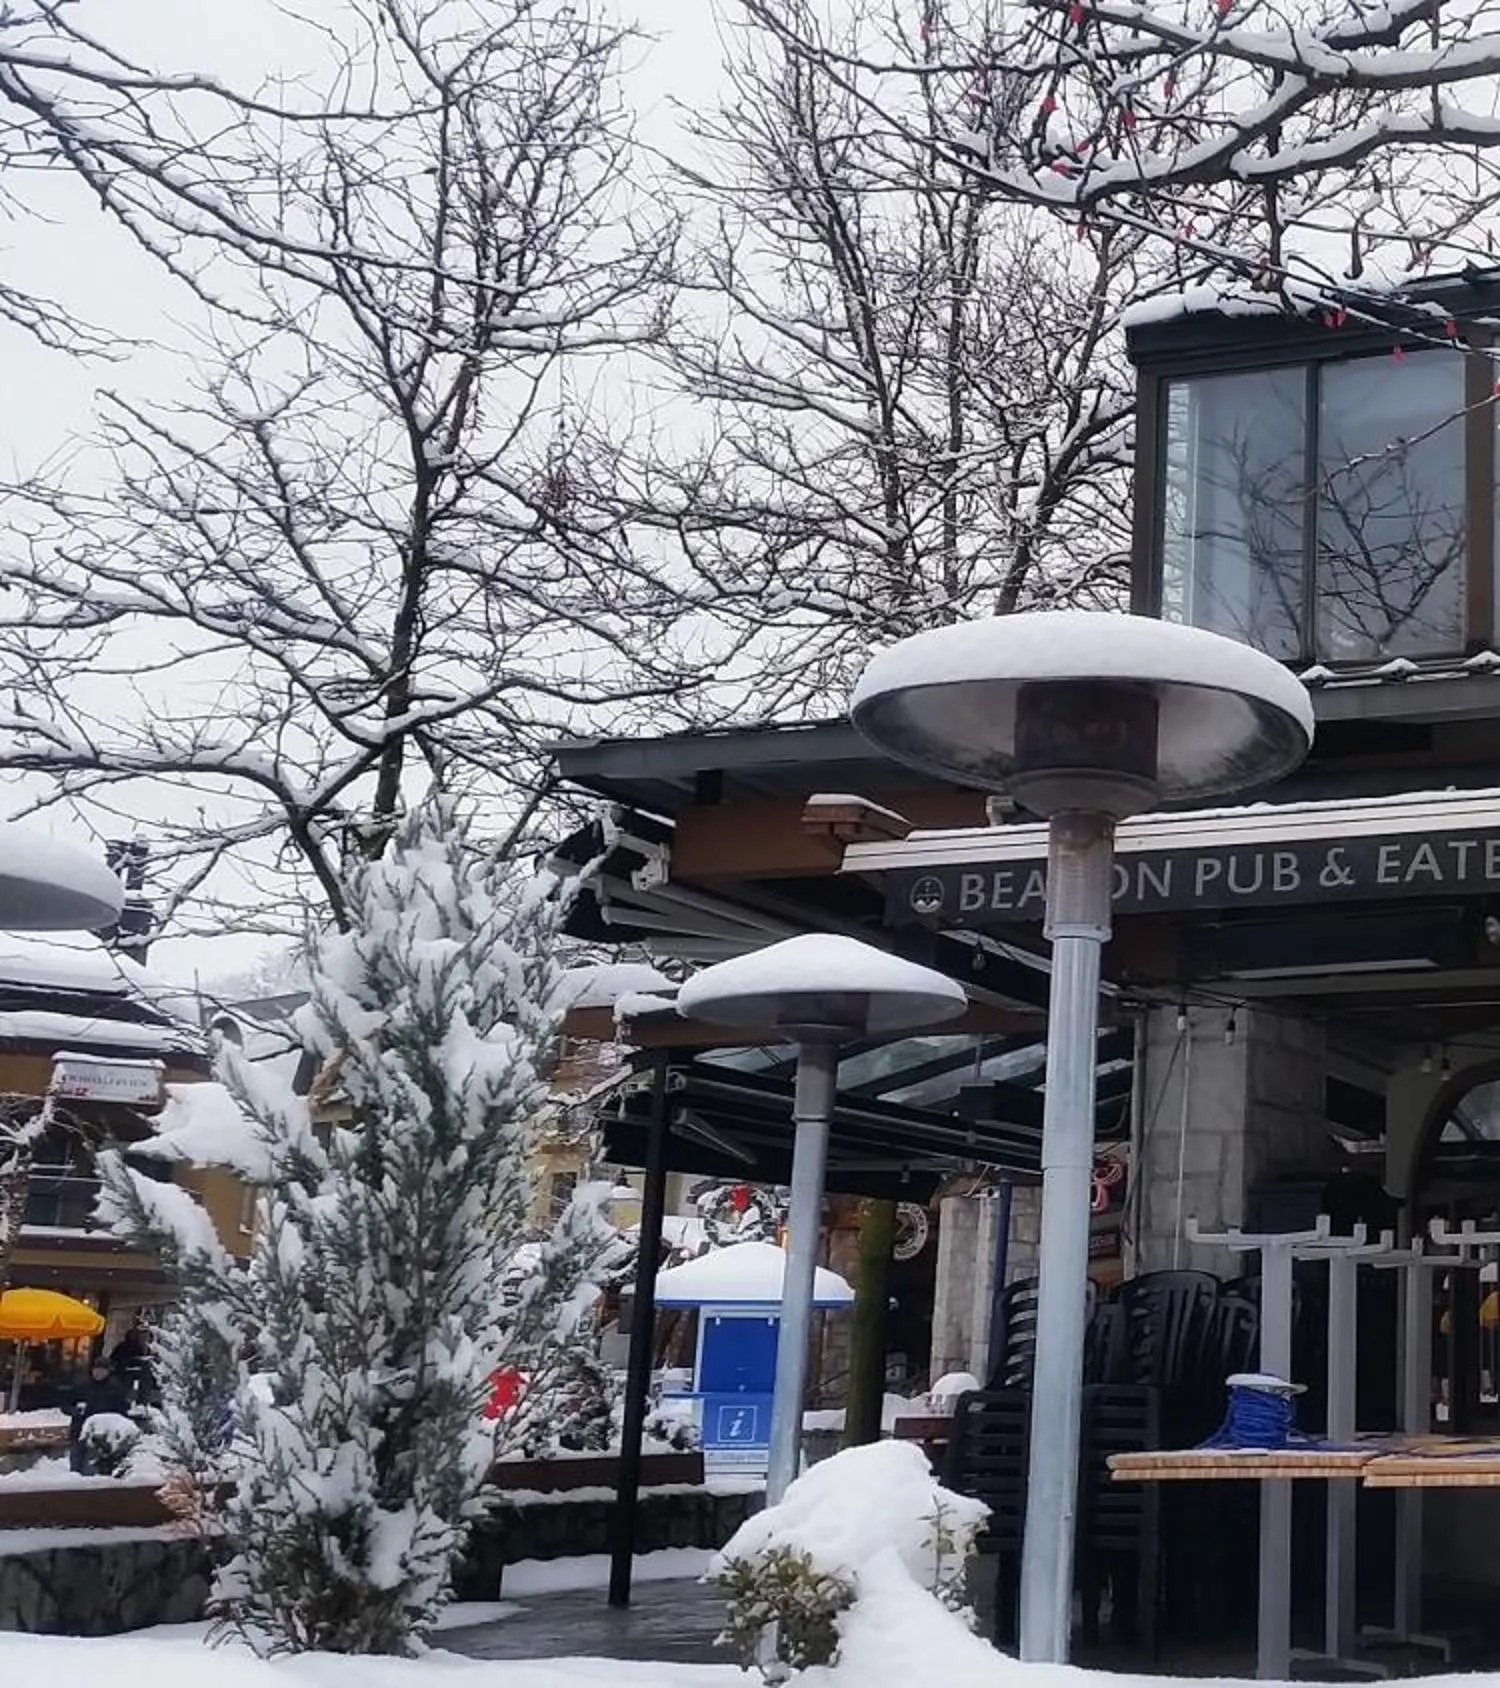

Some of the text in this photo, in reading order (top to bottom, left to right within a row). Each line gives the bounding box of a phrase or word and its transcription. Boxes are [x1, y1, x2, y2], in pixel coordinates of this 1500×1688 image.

[959, 859, 1172, 911] BEAN
[1195, 853, 1300, 896] PUB
[1319, 847, 1356, 887] &
